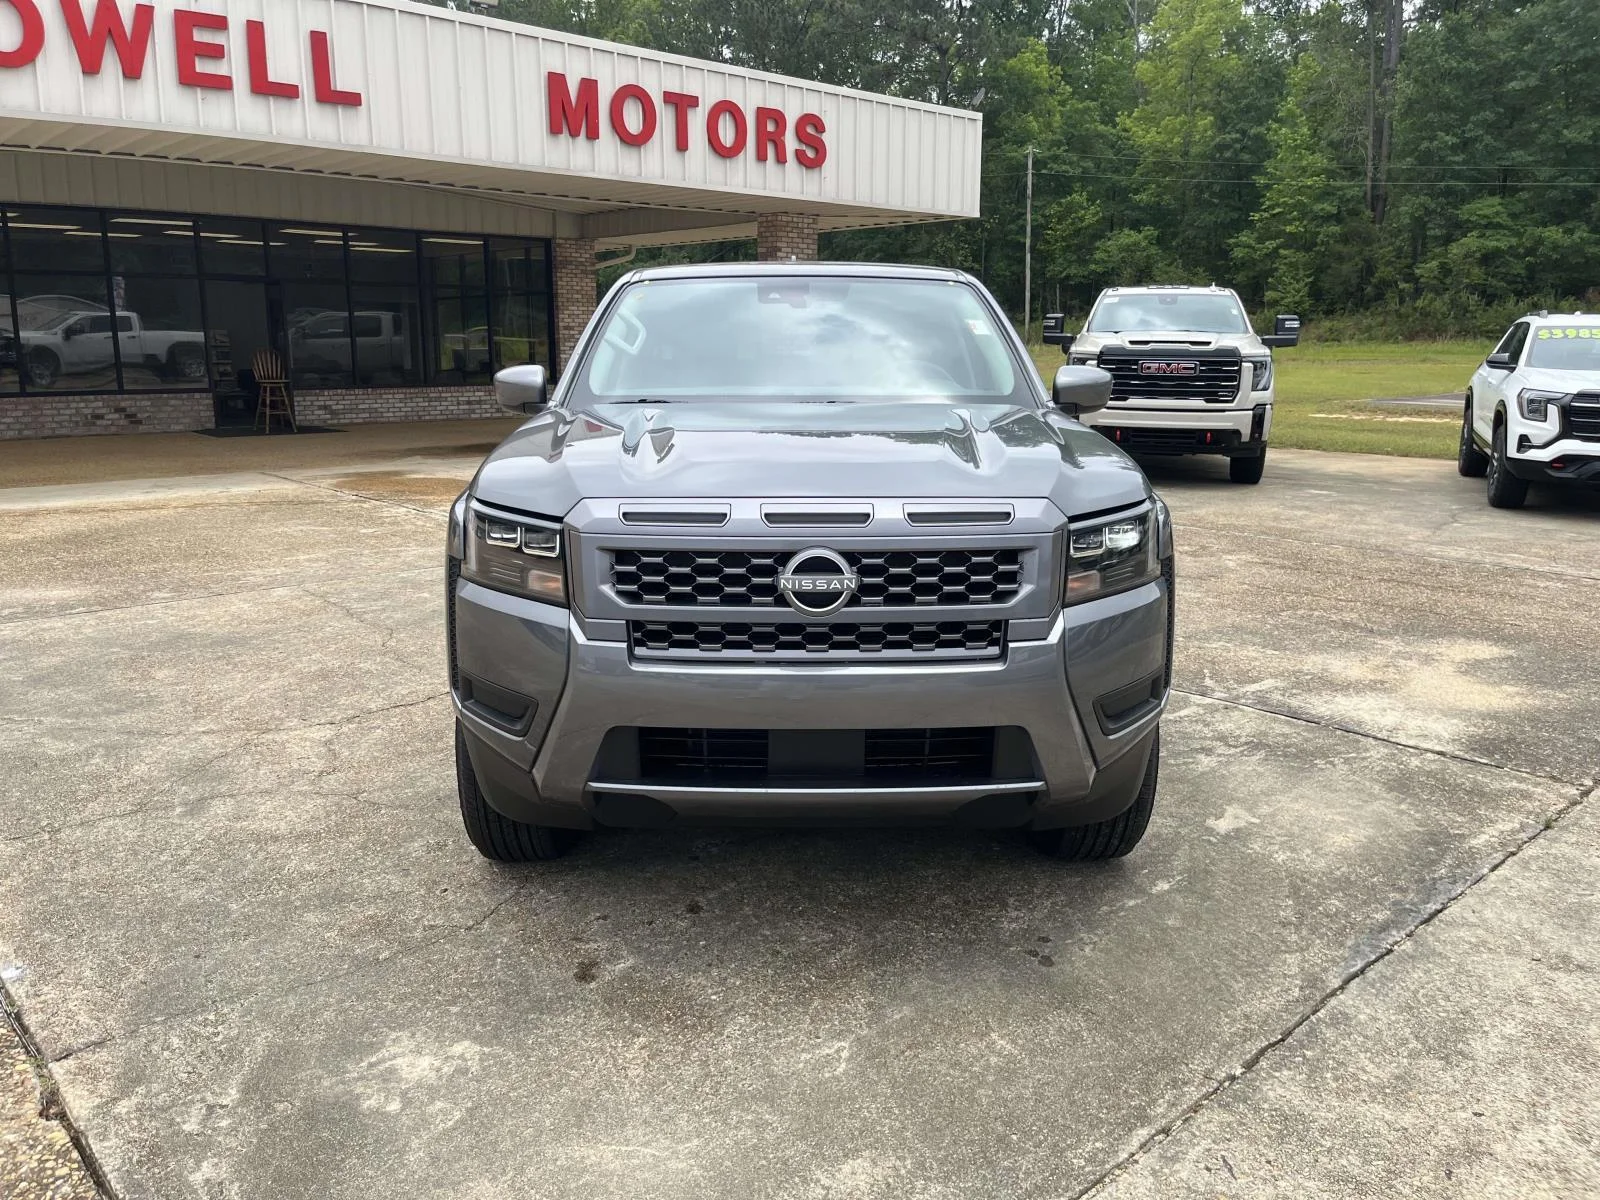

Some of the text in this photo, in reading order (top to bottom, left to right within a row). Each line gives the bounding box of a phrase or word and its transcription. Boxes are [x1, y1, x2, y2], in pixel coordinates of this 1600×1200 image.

[547, 71, 827, 169] MOTORS
[1142, 363, 1195, 374] GMC
[780, 579, 855, 590] NISSAN
